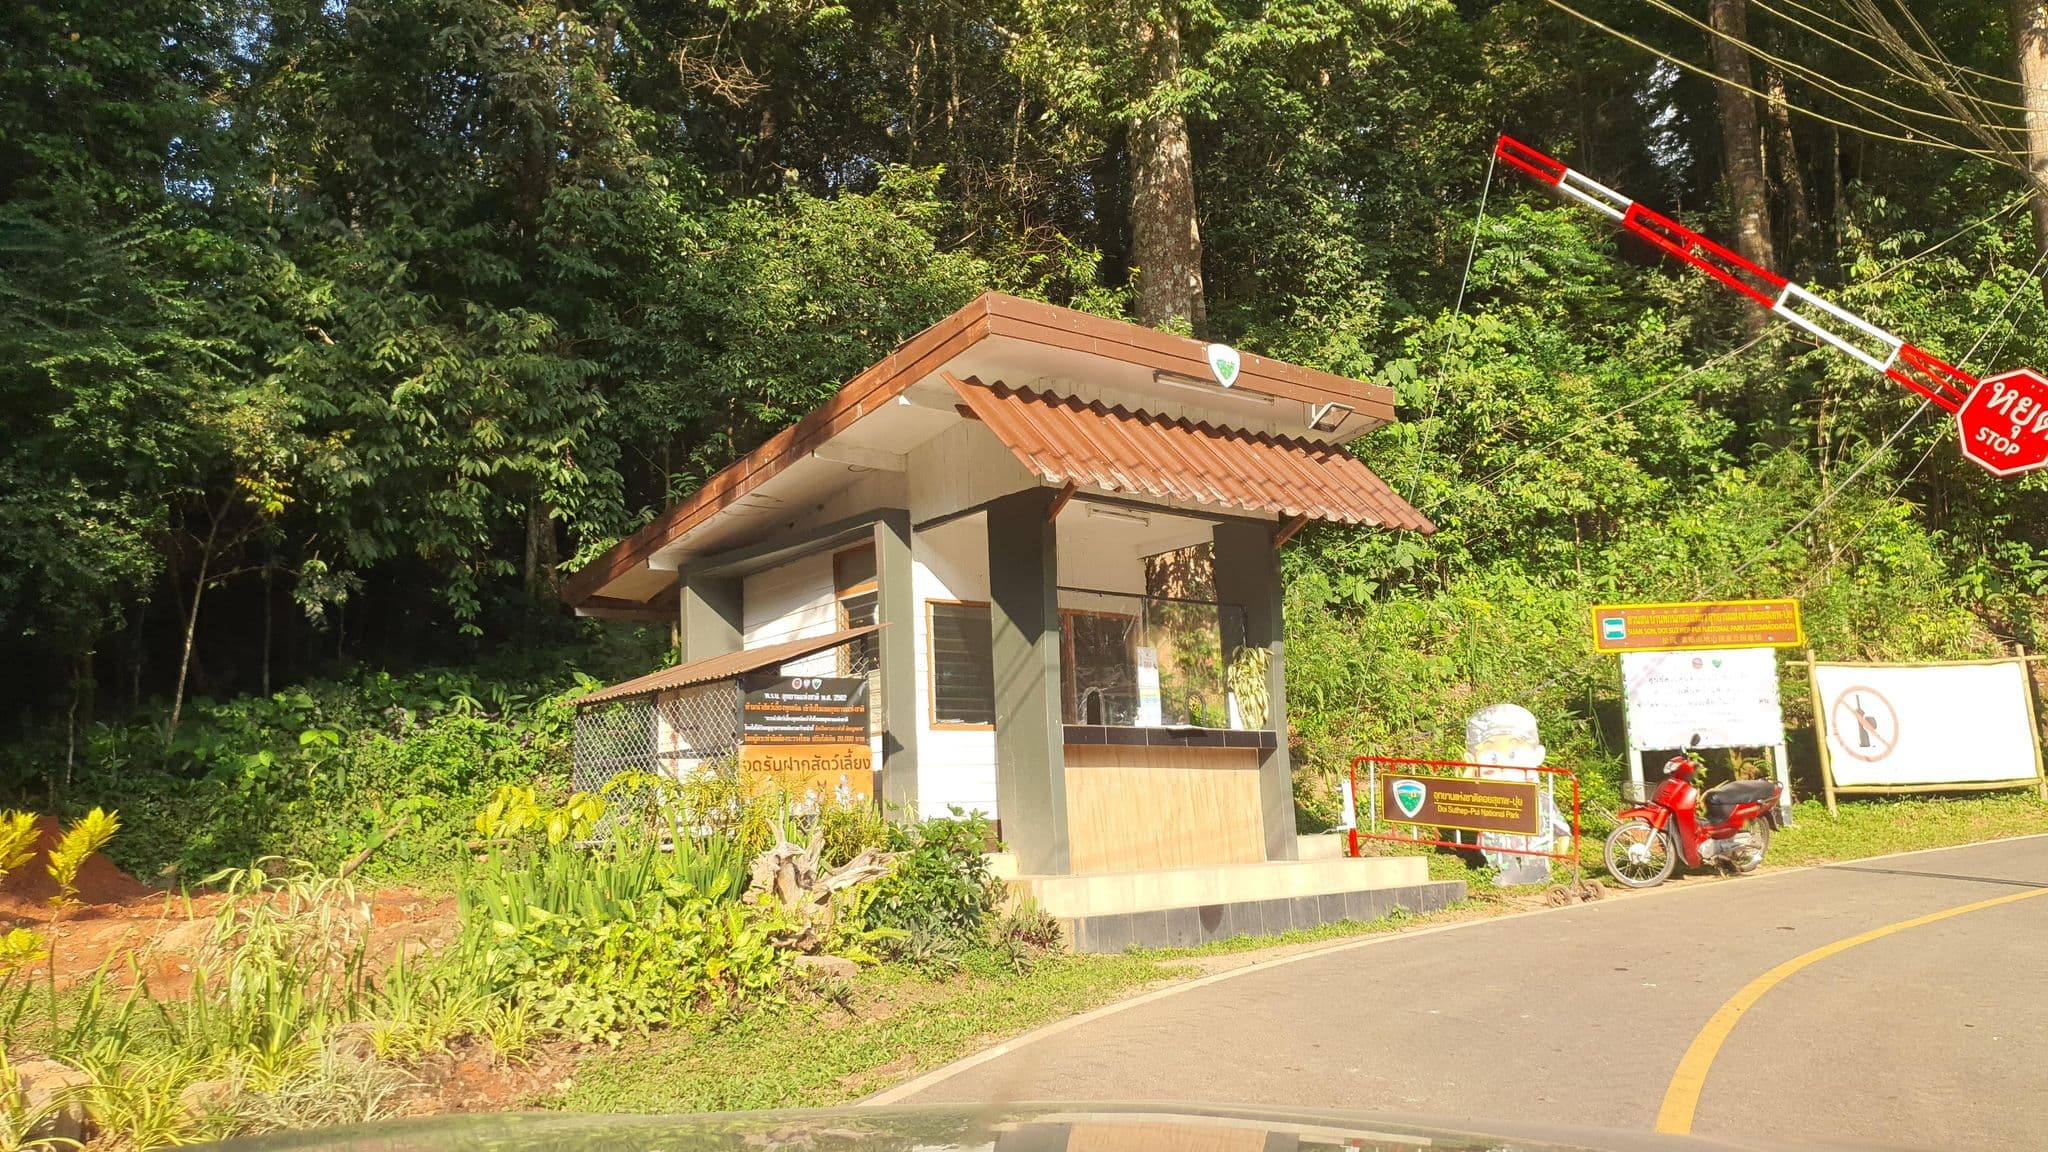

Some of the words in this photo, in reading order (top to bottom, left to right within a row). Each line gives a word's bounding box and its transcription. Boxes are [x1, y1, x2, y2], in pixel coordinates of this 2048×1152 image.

[1975, 426, 2021, 456] STOP
[742, 748, 871, 772] จดรับฝากสัตว์เลี้ยง
[1437, 804, 1447, 813] Doi
[1447, 805, 1480, 816] Suthep-Pui
[1481, 808, 1505, 818] National
[1505, 810, 1521, 819] Park
